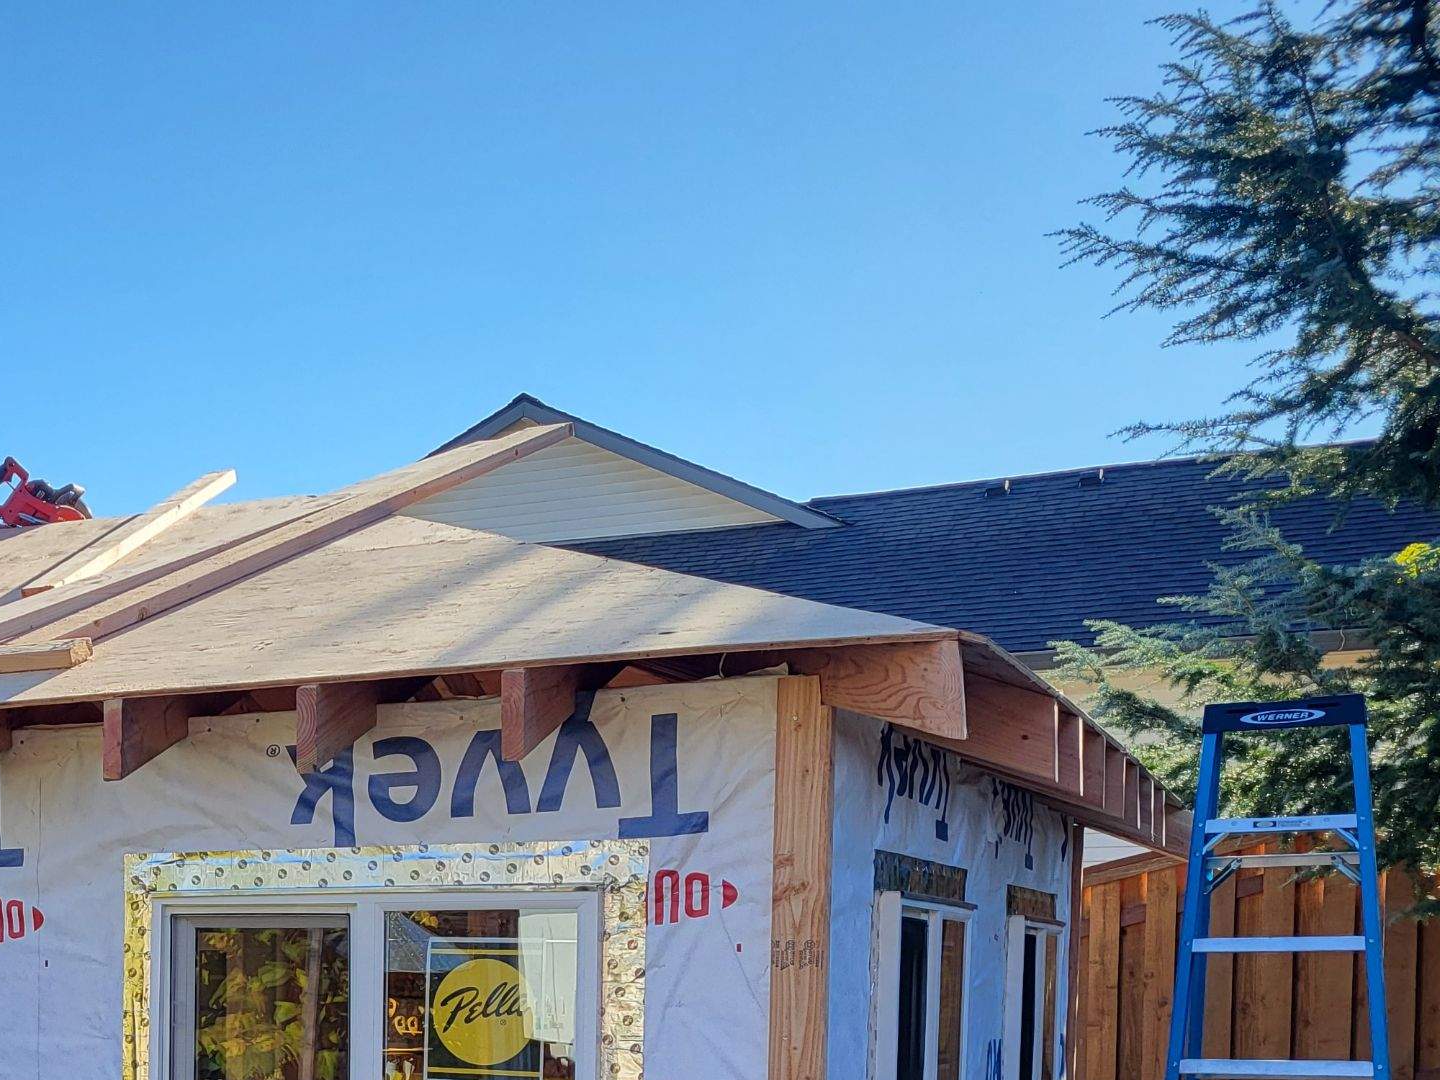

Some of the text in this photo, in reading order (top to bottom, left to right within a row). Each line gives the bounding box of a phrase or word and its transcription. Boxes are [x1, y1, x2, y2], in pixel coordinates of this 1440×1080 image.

[1257, 711, 1310, 722] WERNER
[287, 690, 709, 848] Tyvek
[646, 869, 710, 925] DU
